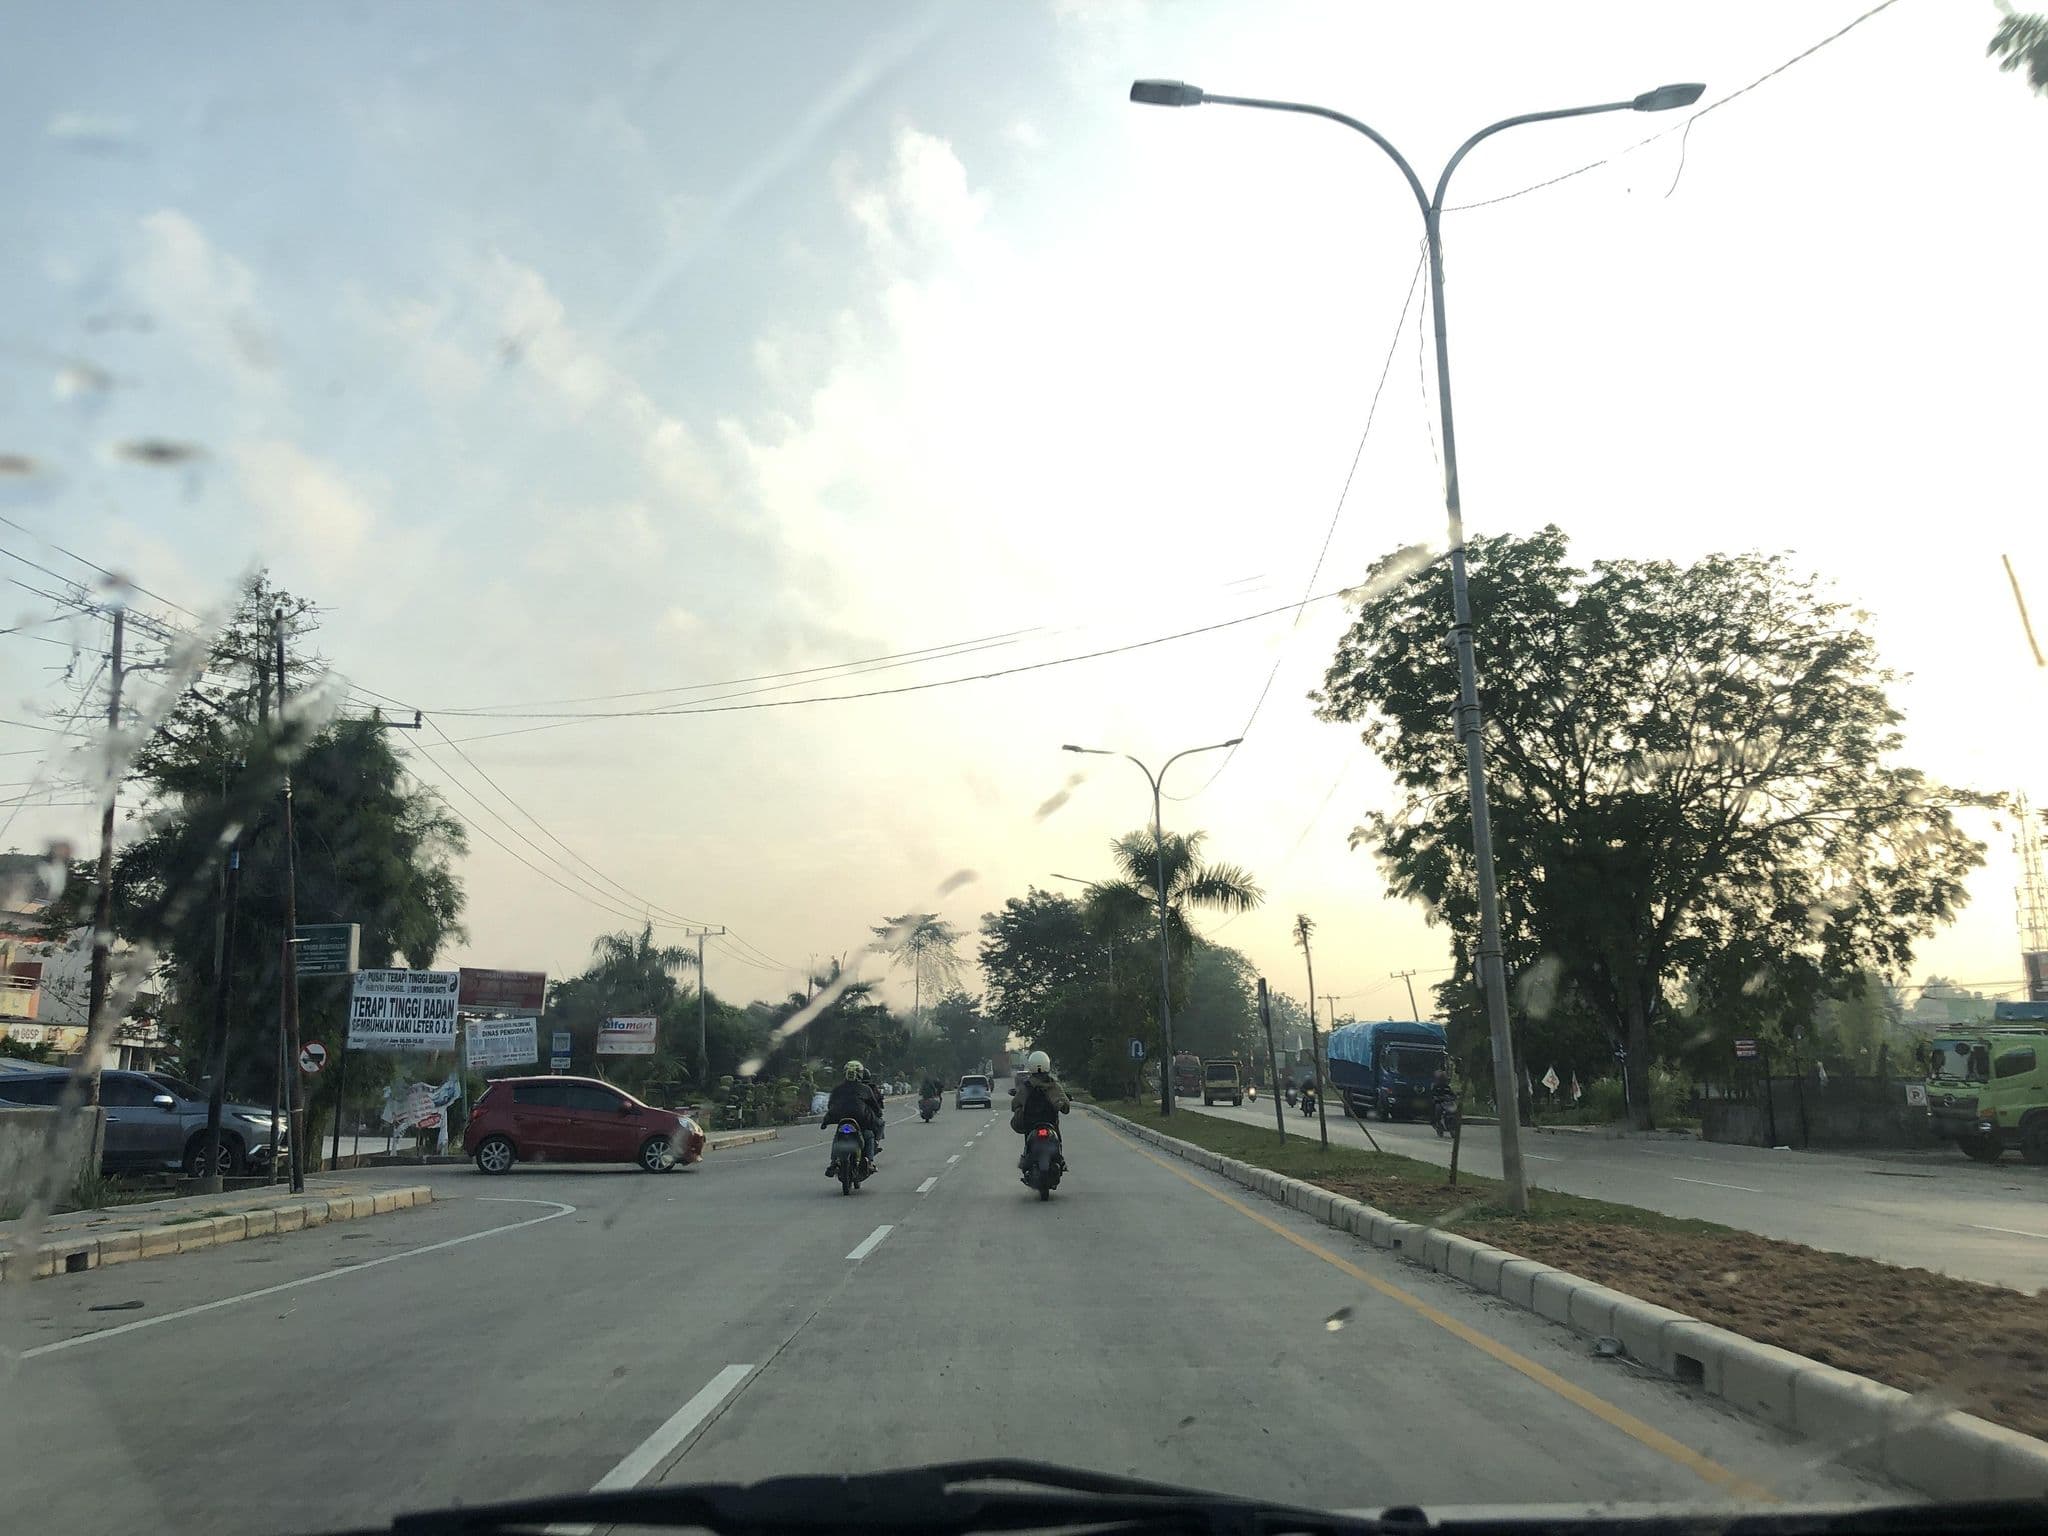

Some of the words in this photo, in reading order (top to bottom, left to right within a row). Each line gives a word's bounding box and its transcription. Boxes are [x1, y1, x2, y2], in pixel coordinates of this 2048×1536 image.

[387, 972, 407, 984] TERAPI
[408, 973, 427, 984] TINGGI
[428, 974, 448, 985] BADAN
[353, 997, 387, 1018] TERAPI
[389, 997, 421, 1019] TINGGI
[423, 998, 455, 1019] BADAN
[352, 1018, 394, 1032] SEMBUHKAN
[395, 1019, 412, 1033] KAKI
[413, 1020, 434, 1033] LETER
[435, 1020, 440, 1034] O
[441, 1020, 446, 1033] &
[448, 1021, 454, 1034] X
[482, 1029, 499, 1037] DINAS
[500, 1027, 534, 1036] PENDIDIKAN
